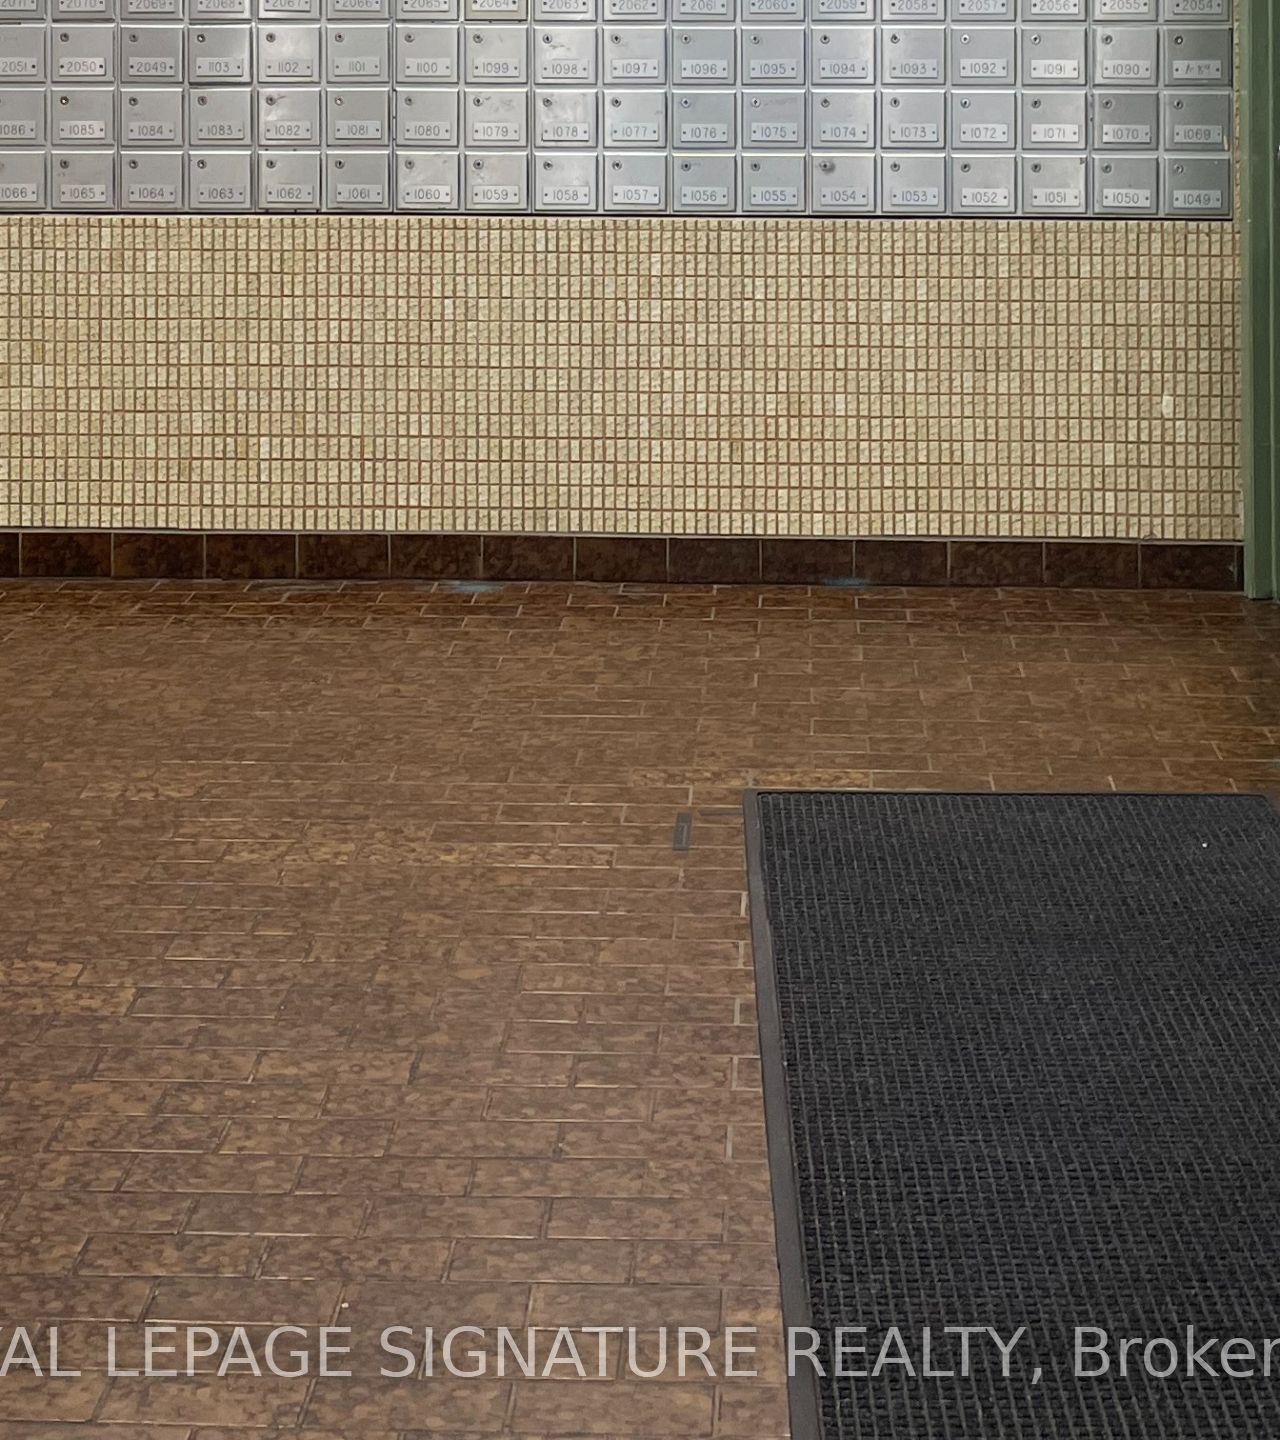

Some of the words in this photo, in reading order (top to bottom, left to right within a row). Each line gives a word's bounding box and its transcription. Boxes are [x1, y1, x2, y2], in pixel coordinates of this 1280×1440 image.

[690, 0, 716, 12] 2061
[967, 0, 998, 12] 2057
[1039, 0, 1071, 12] 2056
[1, 60, 28, 73] 2051
[66, 60, 98, 73] 2050
[136, 61, 167, 73] 2049
[208, 60, 230, 74] 1103
[278, 61, 299, 74] 1102
[348, 60, 366, 73] 1101
[416, 61, 438, 74] 1100
[482, 62, 510, 74] 1099
[551, 63, 578, 76] 1098
[622, 62, 648, 75] 1097
[690, 63, 718, 76] 1096
[759, 62, 787, 75] 1095
[829, 62, 856, 76] 1094
[900, 62, 927, 75] 1093
[970, 62, 997, 74] 1092
[1043, 63, 1066, 76] 1091
[1112, 63, 1140, 76] 1090
[0, 124, 26, 136] 1086
[69, 123, 96, 136] 1085
[137, 124, 164, 137] 1084
[207, 124, 233, 137] 1083
[274, 124, 301, 137] 1082
[347, 124, 369, 137] 1081
[414, 124, 441, 137] 1080
[482, 125, 509, 138] 1079
[552, 125, 578, 138] 1078
[621, 125, 648, 138] 1077
[760, 125, 787, 139] 1075
[830, 126, 856, 138] 1074
[900, 126, 927, 139] 1073
[971, 127, 997, 139] 1072
[1043, 127, 1066, 139] 1071
[1111, 127, 1140, 141] 1070
[1, 186, 28, 199] 1066
[69, 186, 96, 200] 1065
[138, 187, 165, 200] 1064
[208, 187, 234, 200] 1063
[276, 186, 302, 200] 1062
[348, 187, 370, 200] 1061
[414, 188, 441, 200] 1060
[482, 188, 509, 201] 1059
[552, 188, 579, 202] 1058
[622, 189, 649, 201] 1057
[691, 189, 718, 202] 1056
[760, 189, 787, 202] 1055
[830, 190, 856, 202] 1054
[901, 190, 928, 203] 1053
[971, 191, 998, 204] 1052
[1044, 191, 1067, 204] 1051
[1112, 191, 1140, 205] 1050
[1183, 193, 1211, 206] 1049
